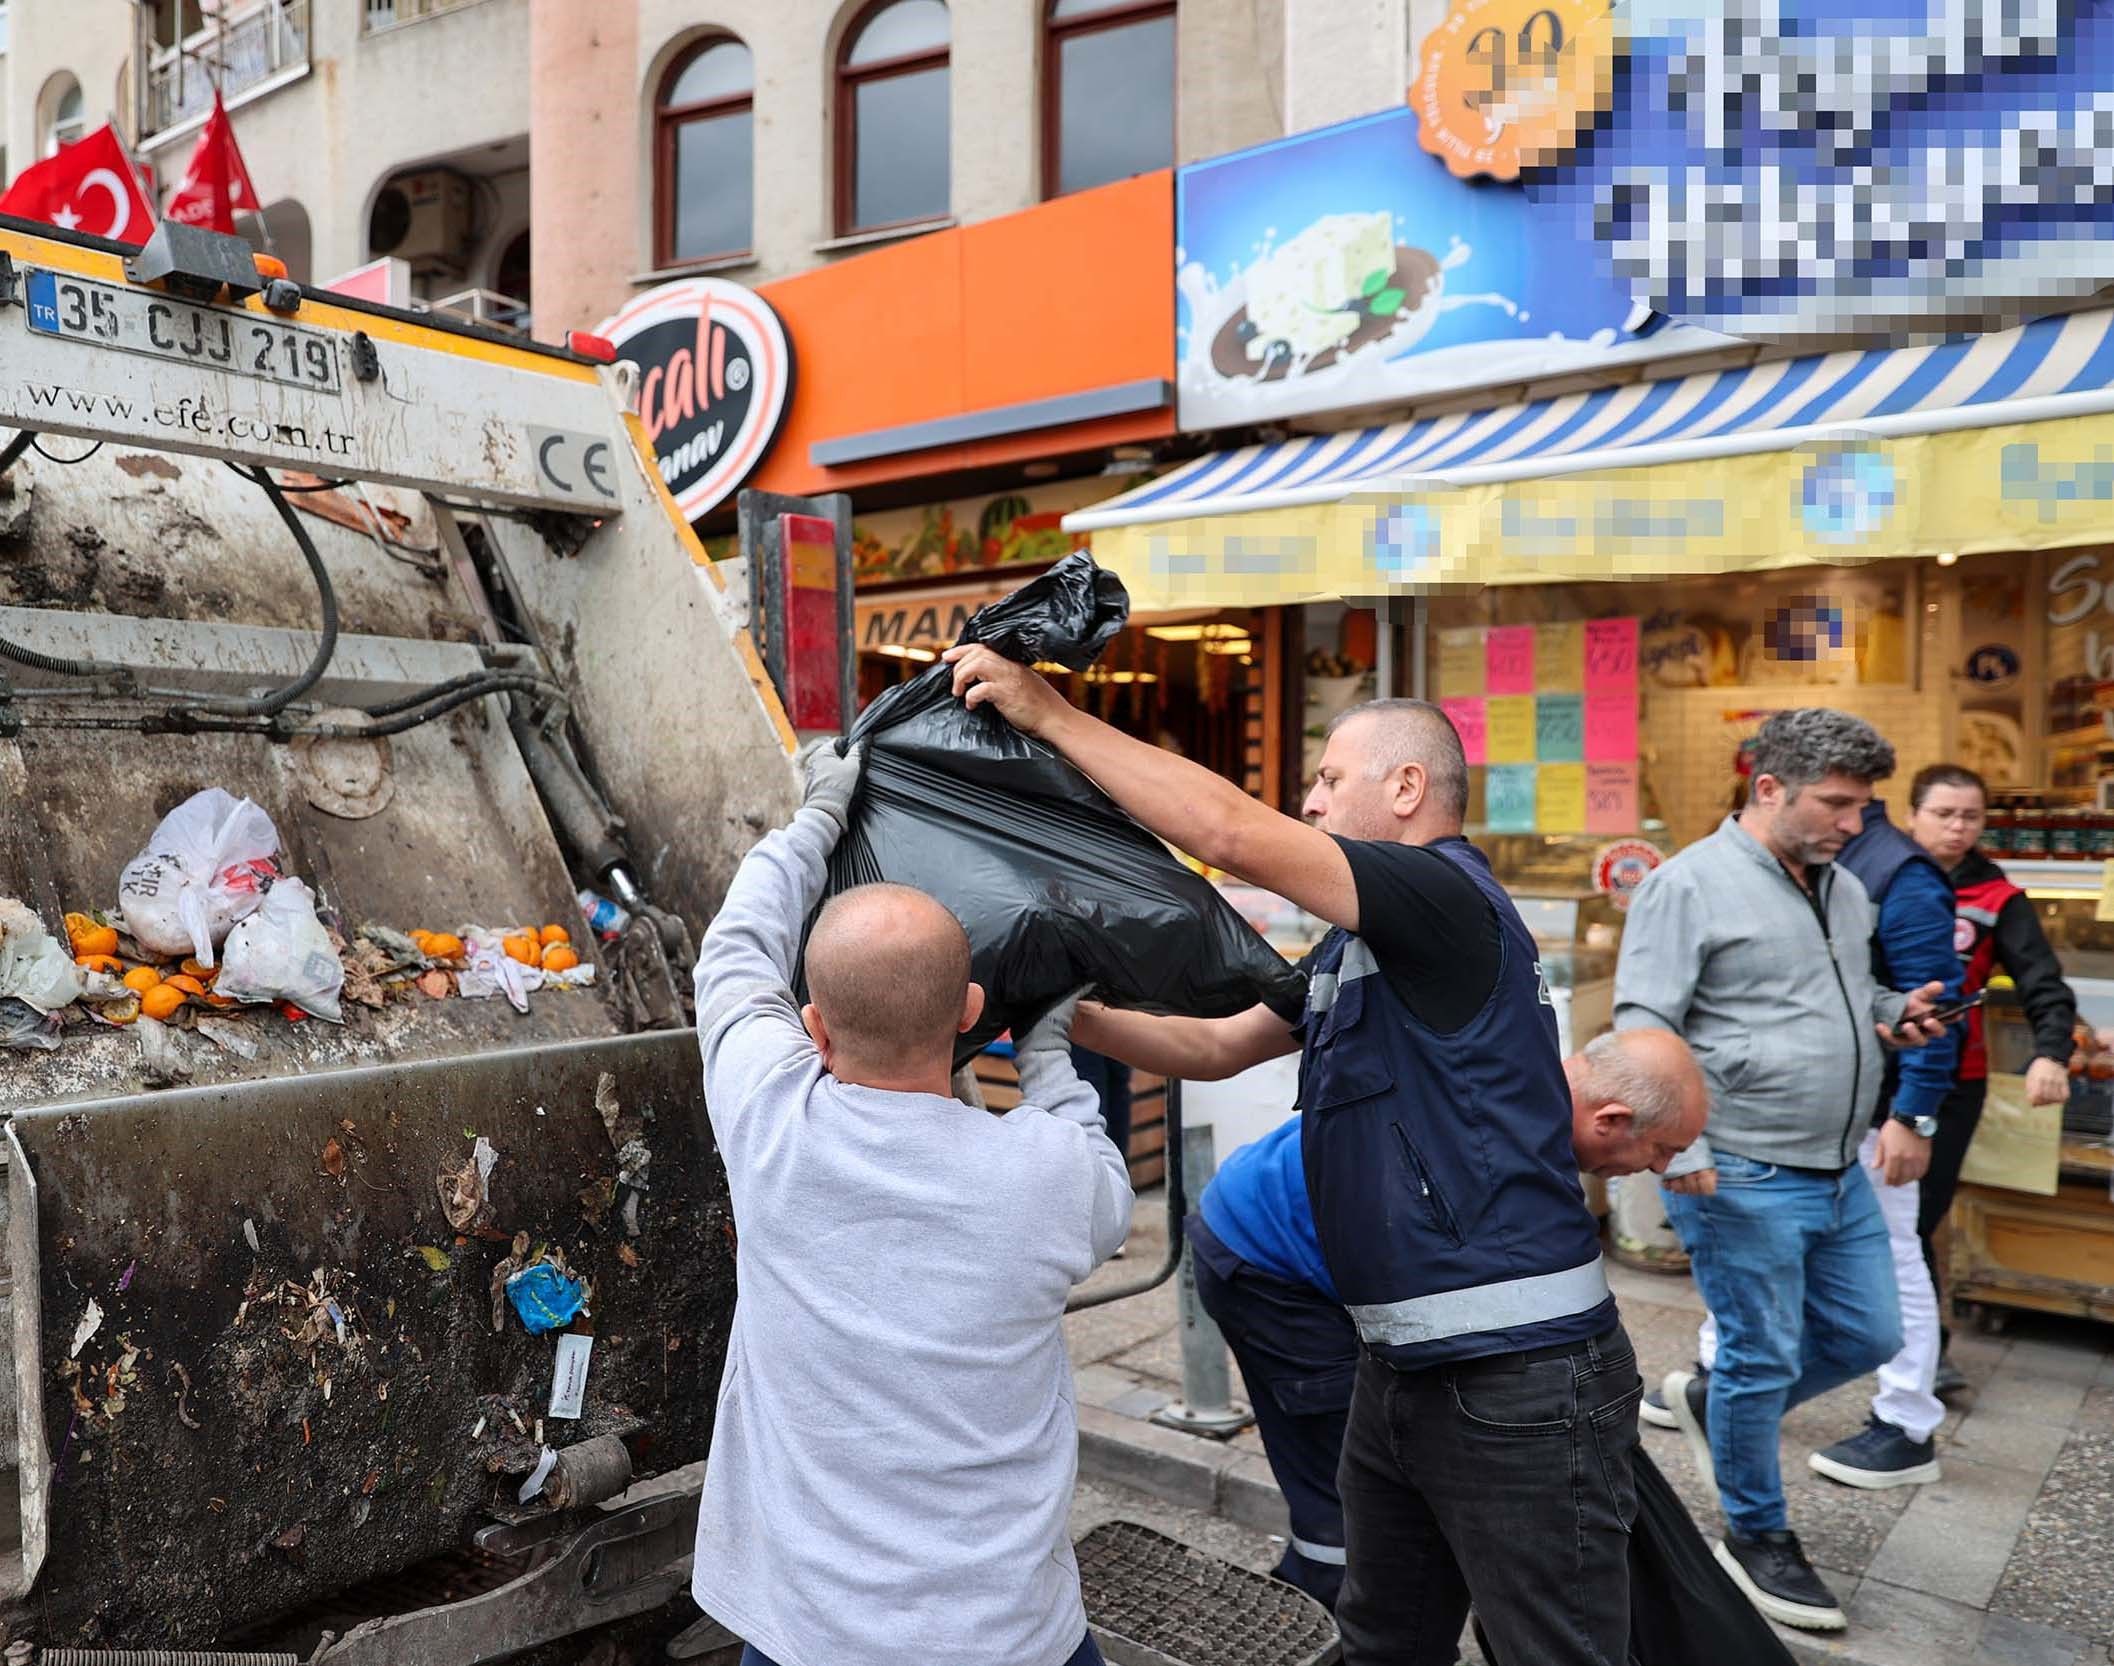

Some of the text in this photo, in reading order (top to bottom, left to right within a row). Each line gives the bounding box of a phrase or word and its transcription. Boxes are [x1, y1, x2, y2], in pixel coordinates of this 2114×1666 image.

[33, 284, 329, 382] TR 35 CJJ 219
[26, 384, 354, 455] www.efe.com.tr
[539, 435, 615, 498] CE
[864, 602, 985, 645] MAN
